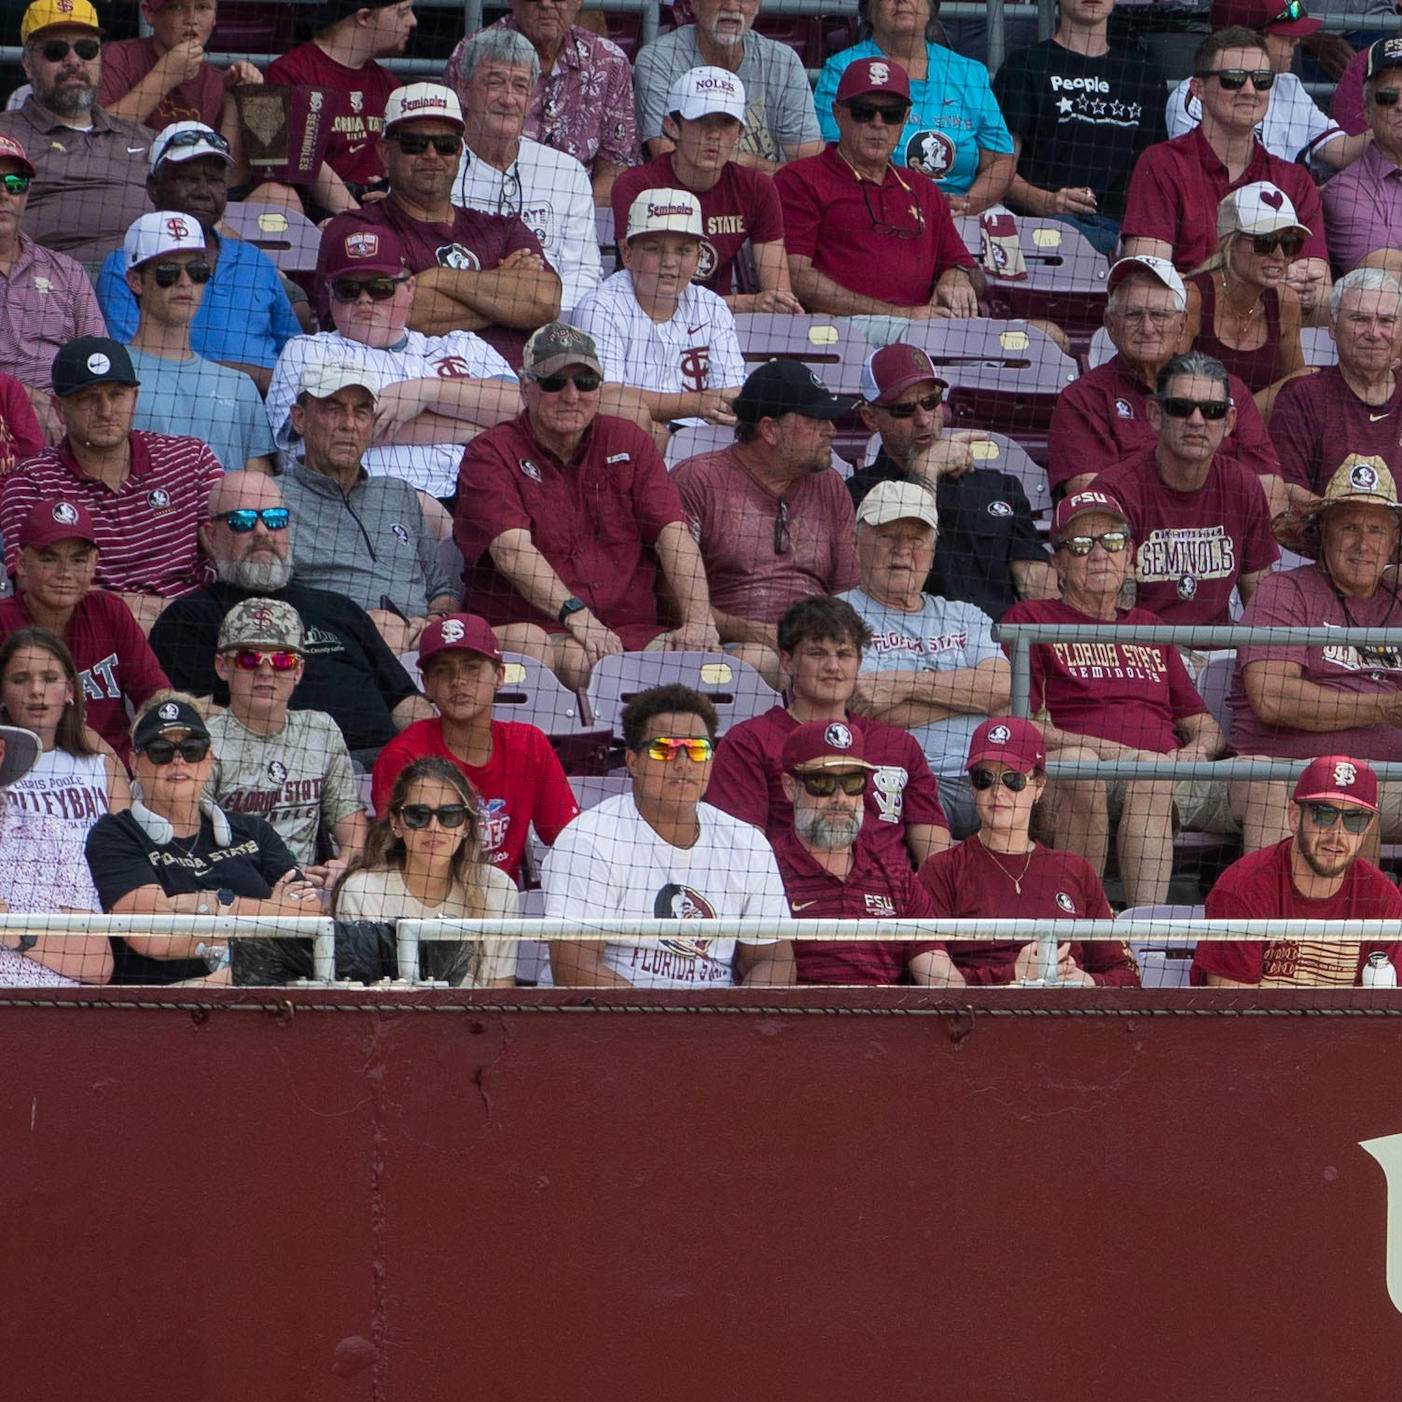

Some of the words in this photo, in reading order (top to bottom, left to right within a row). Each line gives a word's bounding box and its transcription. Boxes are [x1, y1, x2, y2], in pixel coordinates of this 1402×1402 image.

[696, 79, 736, 93] NOLES
[1050, 76, 1109, 94] People
[400, 95, 447, 113] Seminoles
[299, 112, 318, 171] SEMINOLES
[647, 202, 693, 218] Seminoles
[708, 215, 746, 234] STATE
[1070, 491, 1107, 508] FSU
[872, 633, 926, 655] FLORIDA
[930, 631, 968, 654] STATE
[1053, 643, 1115, 668] FLORIDA
[1123, 643, 1167, 673] STATE
[15, 777, 49, 791] CHRIS
[51, 776, 85, 790] POOLE
[209, 840, 259, 863] STATE
[864, 894, 894, 910] FSU
[632, 948, 697, 982] FLORIDA
